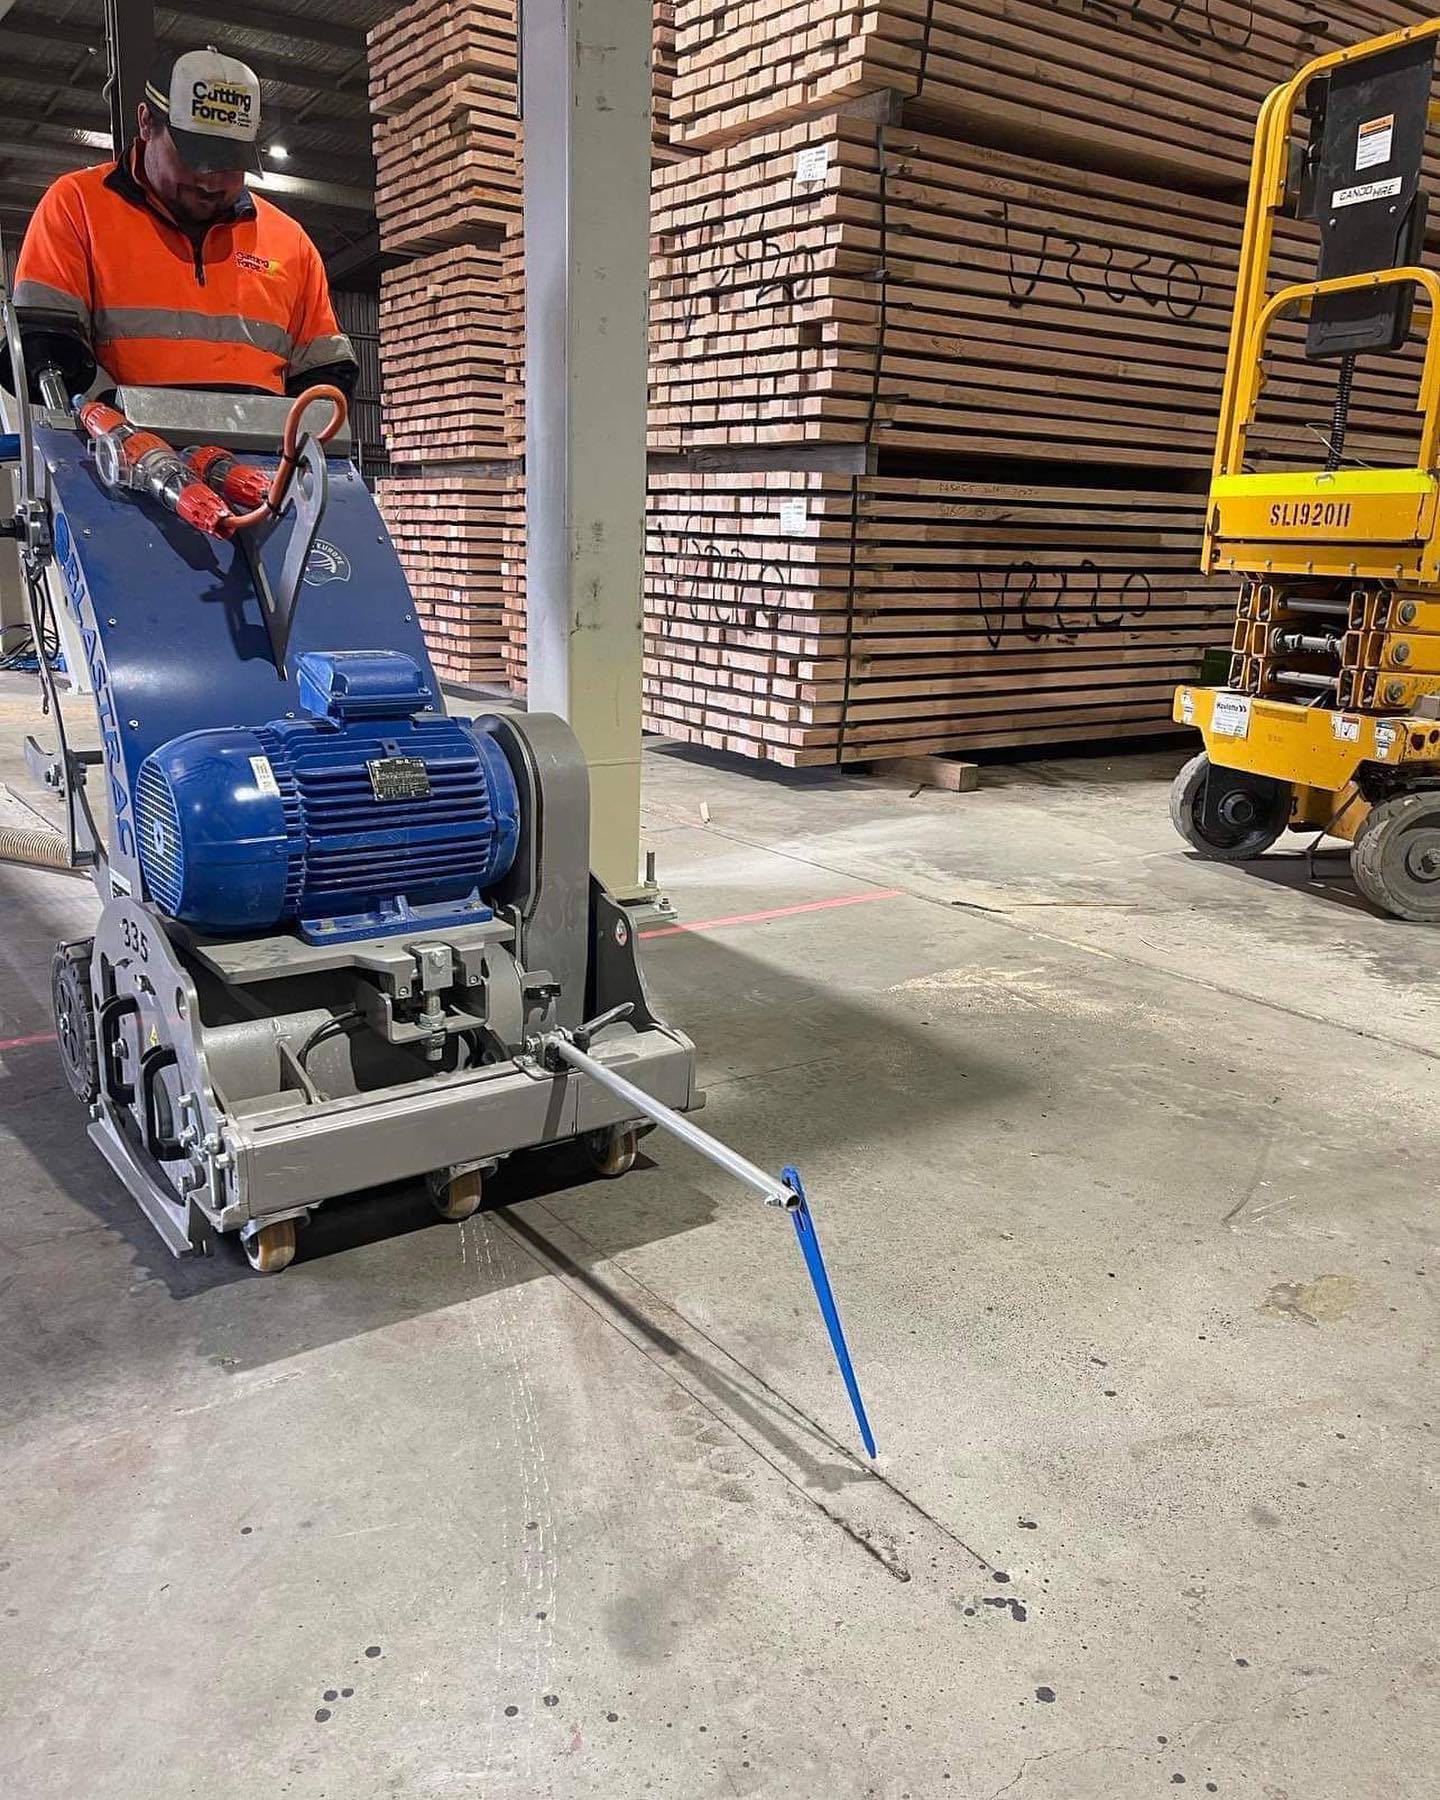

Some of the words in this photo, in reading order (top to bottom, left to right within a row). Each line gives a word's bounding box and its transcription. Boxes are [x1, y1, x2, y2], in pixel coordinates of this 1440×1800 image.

[193, 81, 252, 113] Cutting
[68, 556, 136, 860] BLASTRAC
[121, 917, 149, 964] 335
